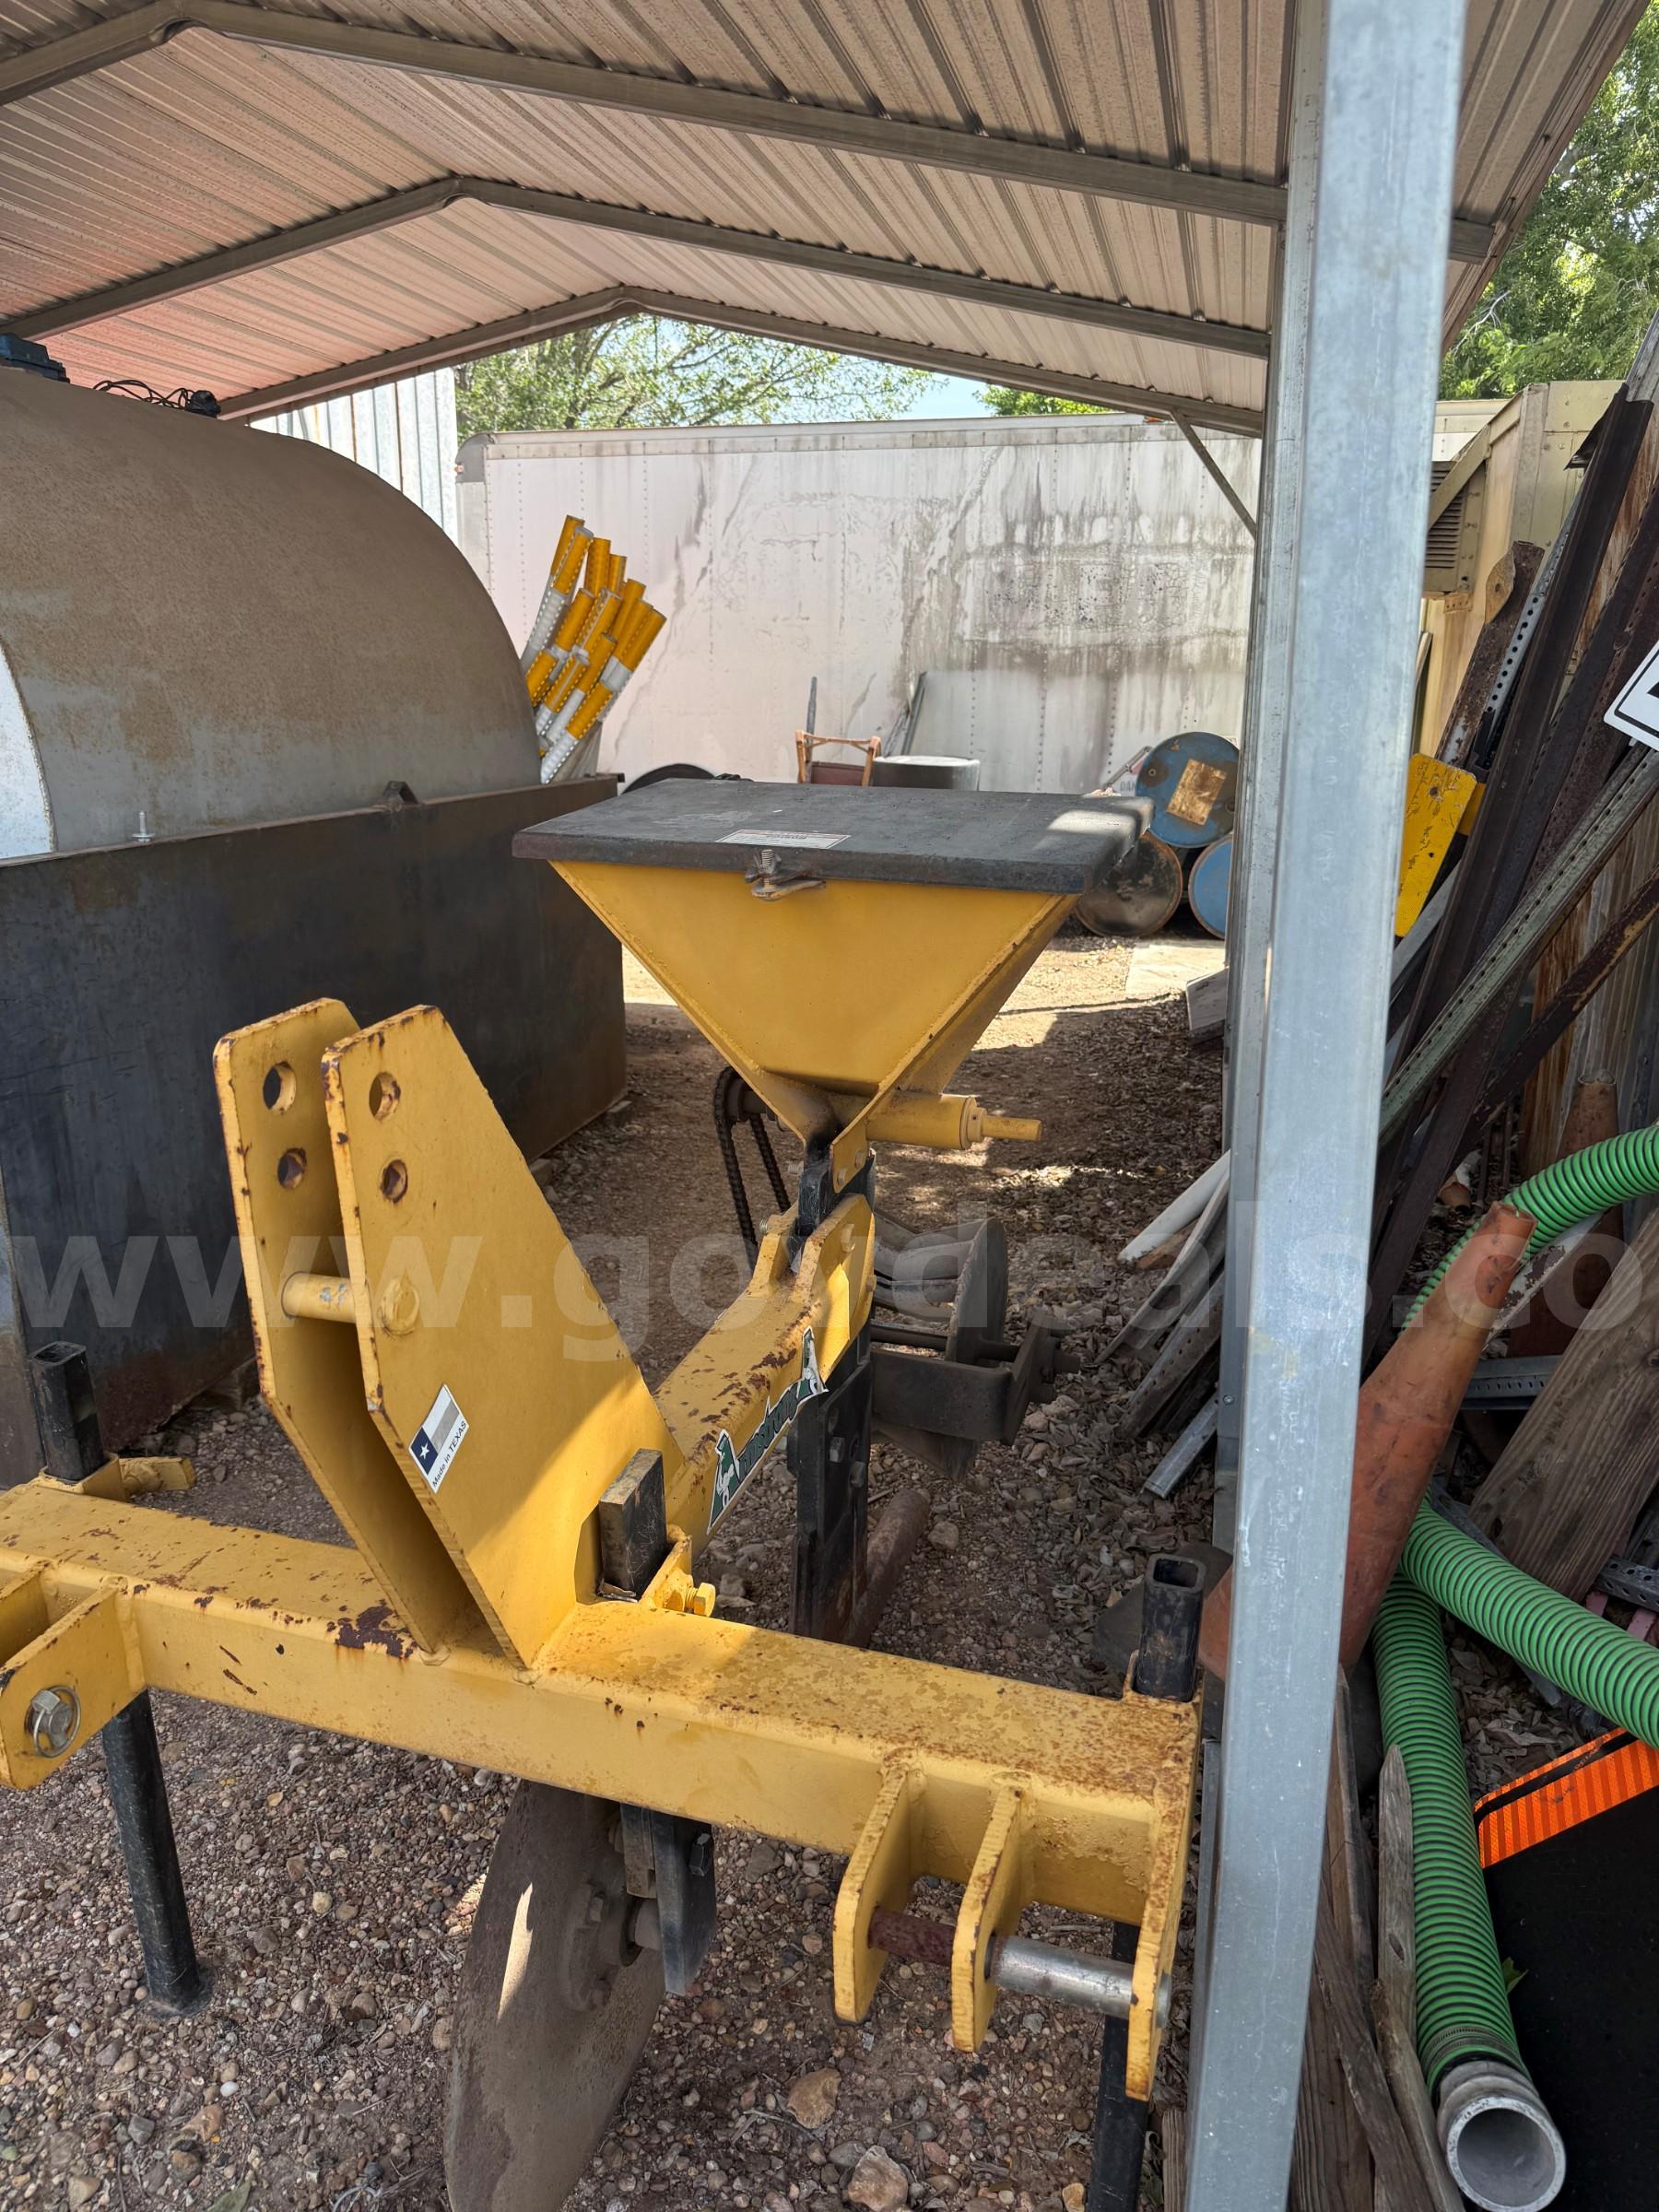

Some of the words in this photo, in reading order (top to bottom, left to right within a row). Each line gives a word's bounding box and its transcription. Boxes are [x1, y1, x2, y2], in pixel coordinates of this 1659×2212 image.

[432, 1464, 445, 1487] Made
[444, 1453, 452, 1464] in
[449, 1420, 466, 1453] TEXAS
